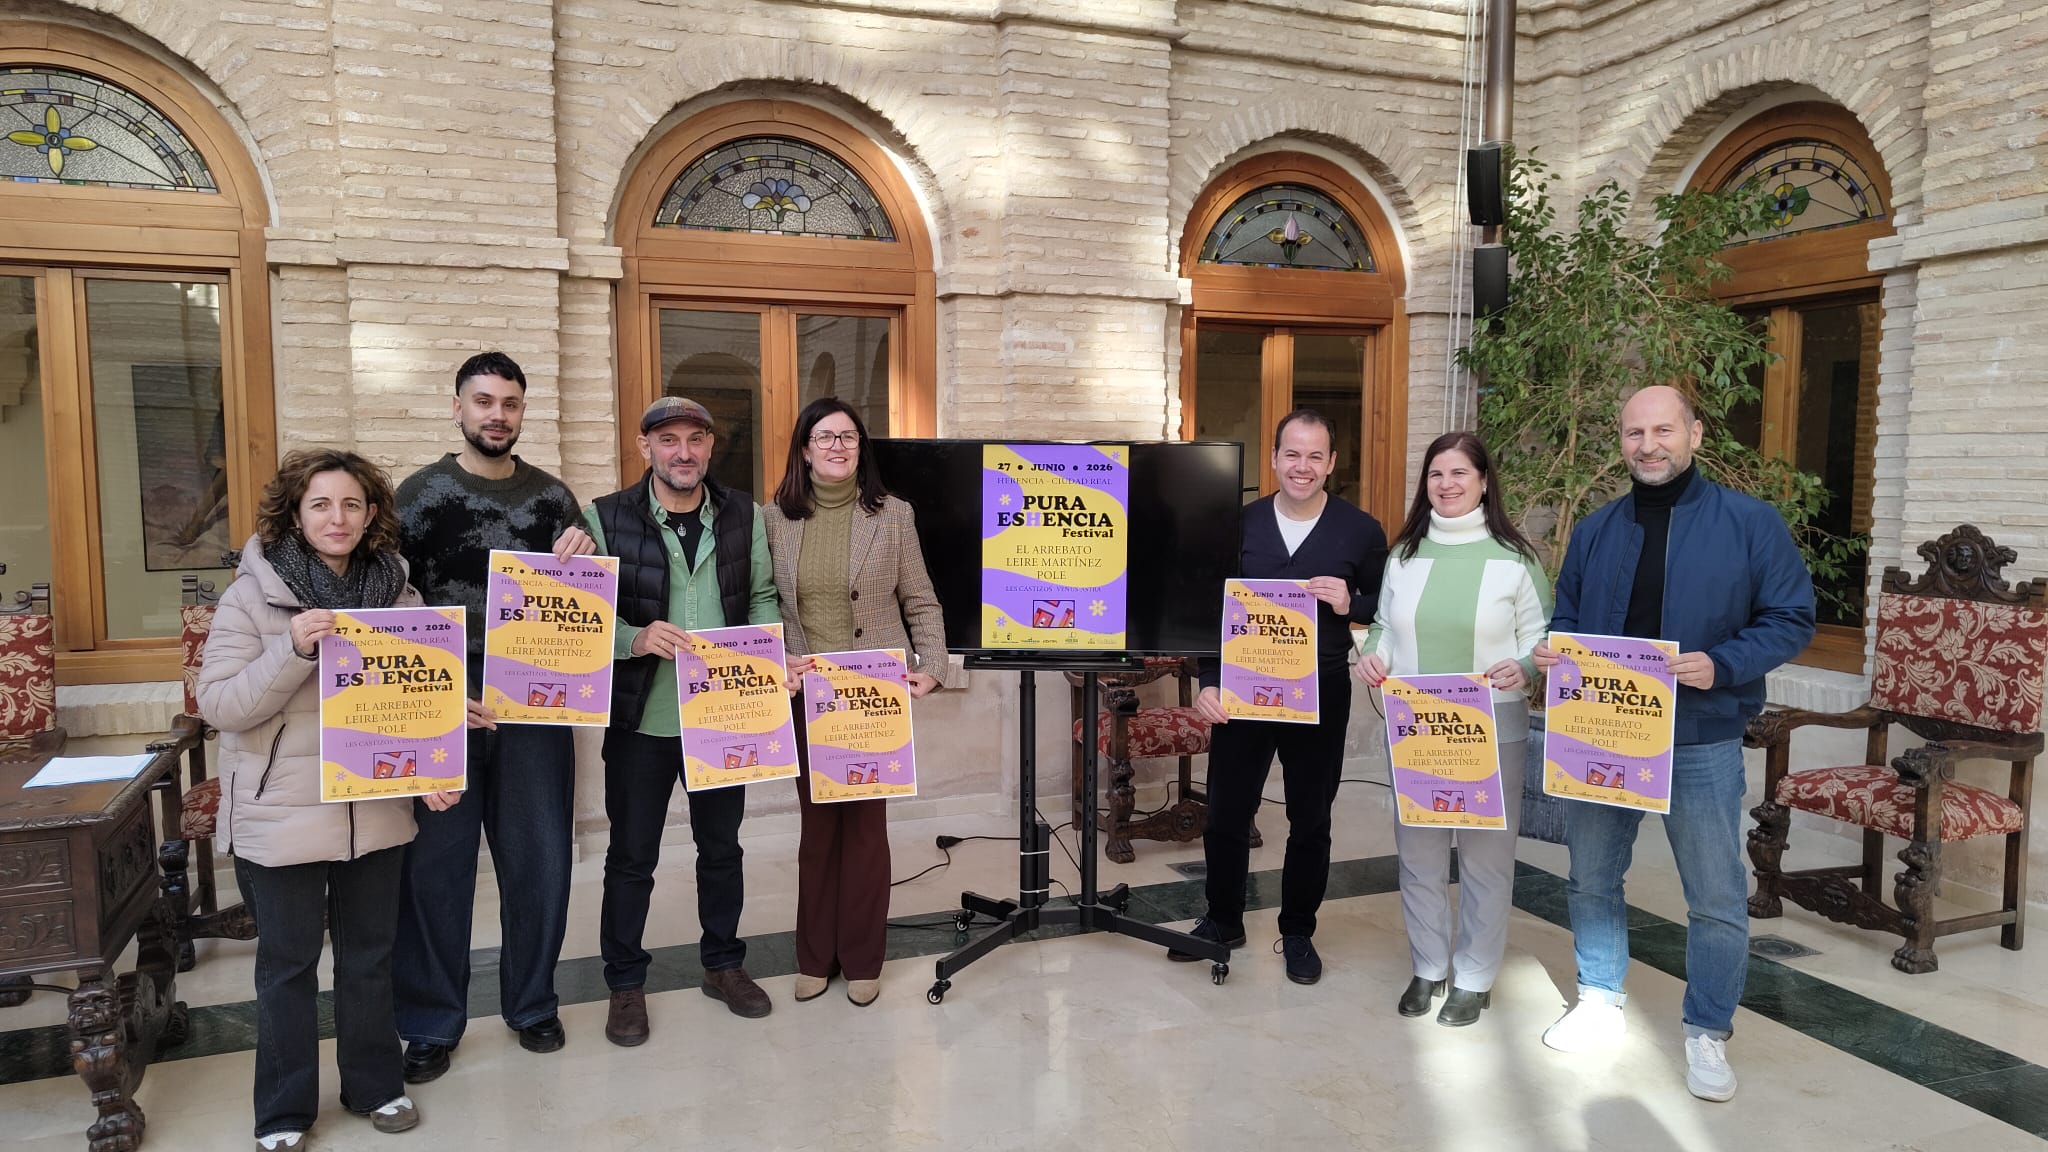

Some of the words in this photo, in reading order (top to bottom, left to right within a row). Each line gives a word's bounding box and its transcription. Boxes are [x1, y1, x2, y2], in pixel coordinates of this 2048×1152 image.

[998, 463, 1010, 471] 27
[1023, 496, 1086, 510] PURA
[997, 512, 1113, 527] ESHENCIA
[1062, 529, 1113, 538] Festival
[1016, 545, 1029, 554] EL
[1033, 546, 1092, 554] ARREBATO
[1006, 558, 1038, 566] LEIRE
[1037, 571, 1066, 579] POLE
[523, 595, 580, 609] PURA
[500, 608, 603, 624] ESHENCIA
[1247, 614, 1288, 625] PURA
[558, 624, 603, 633] Festival
[1231, 625, 1307, 637] ESHENCIA
[516, 637, 529, 645] EL
[530, 638, 583, 646] ARREBATO
[1272, 637, 1308, 645] Festival
[506, 647, 534, 655] LEIRE
[362, 654, 426, 670] PURA
[1640, 654, 1664, 662] 2026
[708, 664, 755, 679] PURA
[336, 668, 452, 687] ESHENCIA
[402, 683, 452, 693] Festival
[689, 675, 776, 694] ESHENCIA
[1581, 676, 1638, 692] PURA
[740, 687, 778, 697] Festival
[834, 686, 880, 699] PURA
[1559, 687, 1662, 708] ESHENCIA
[372, 700, 431, 711] ARREBATO
[706, 706, 715, 714] EL
[718, 702, 764, 712] ARREBATO
[816, 697, 900, 713] ESHENCIA
[864, 708, 901, 717] Festival
[1616, 706, 1662, 718] Festival
[346, 713, 378, 724] LEIRE
[699, 715, 724, 724] LEIRE
[1415, 712, 1463, 723] PURA
[724, 723, 746, 731] POLE
[843, 721, 886, 731] ARREBATO
[1588, 718, 1641, 729] ARREBATO
[377, 724, 406, 734] POLE
[1397, 724, 1485, 736] ESHENCIA
[1566, 725, 1593, 734] LEIRE
[825, 734, 848, 742] LEIRE
[1447, 736, 1486, 744] Festival
[1592, 738, 1617, 748] POLE
